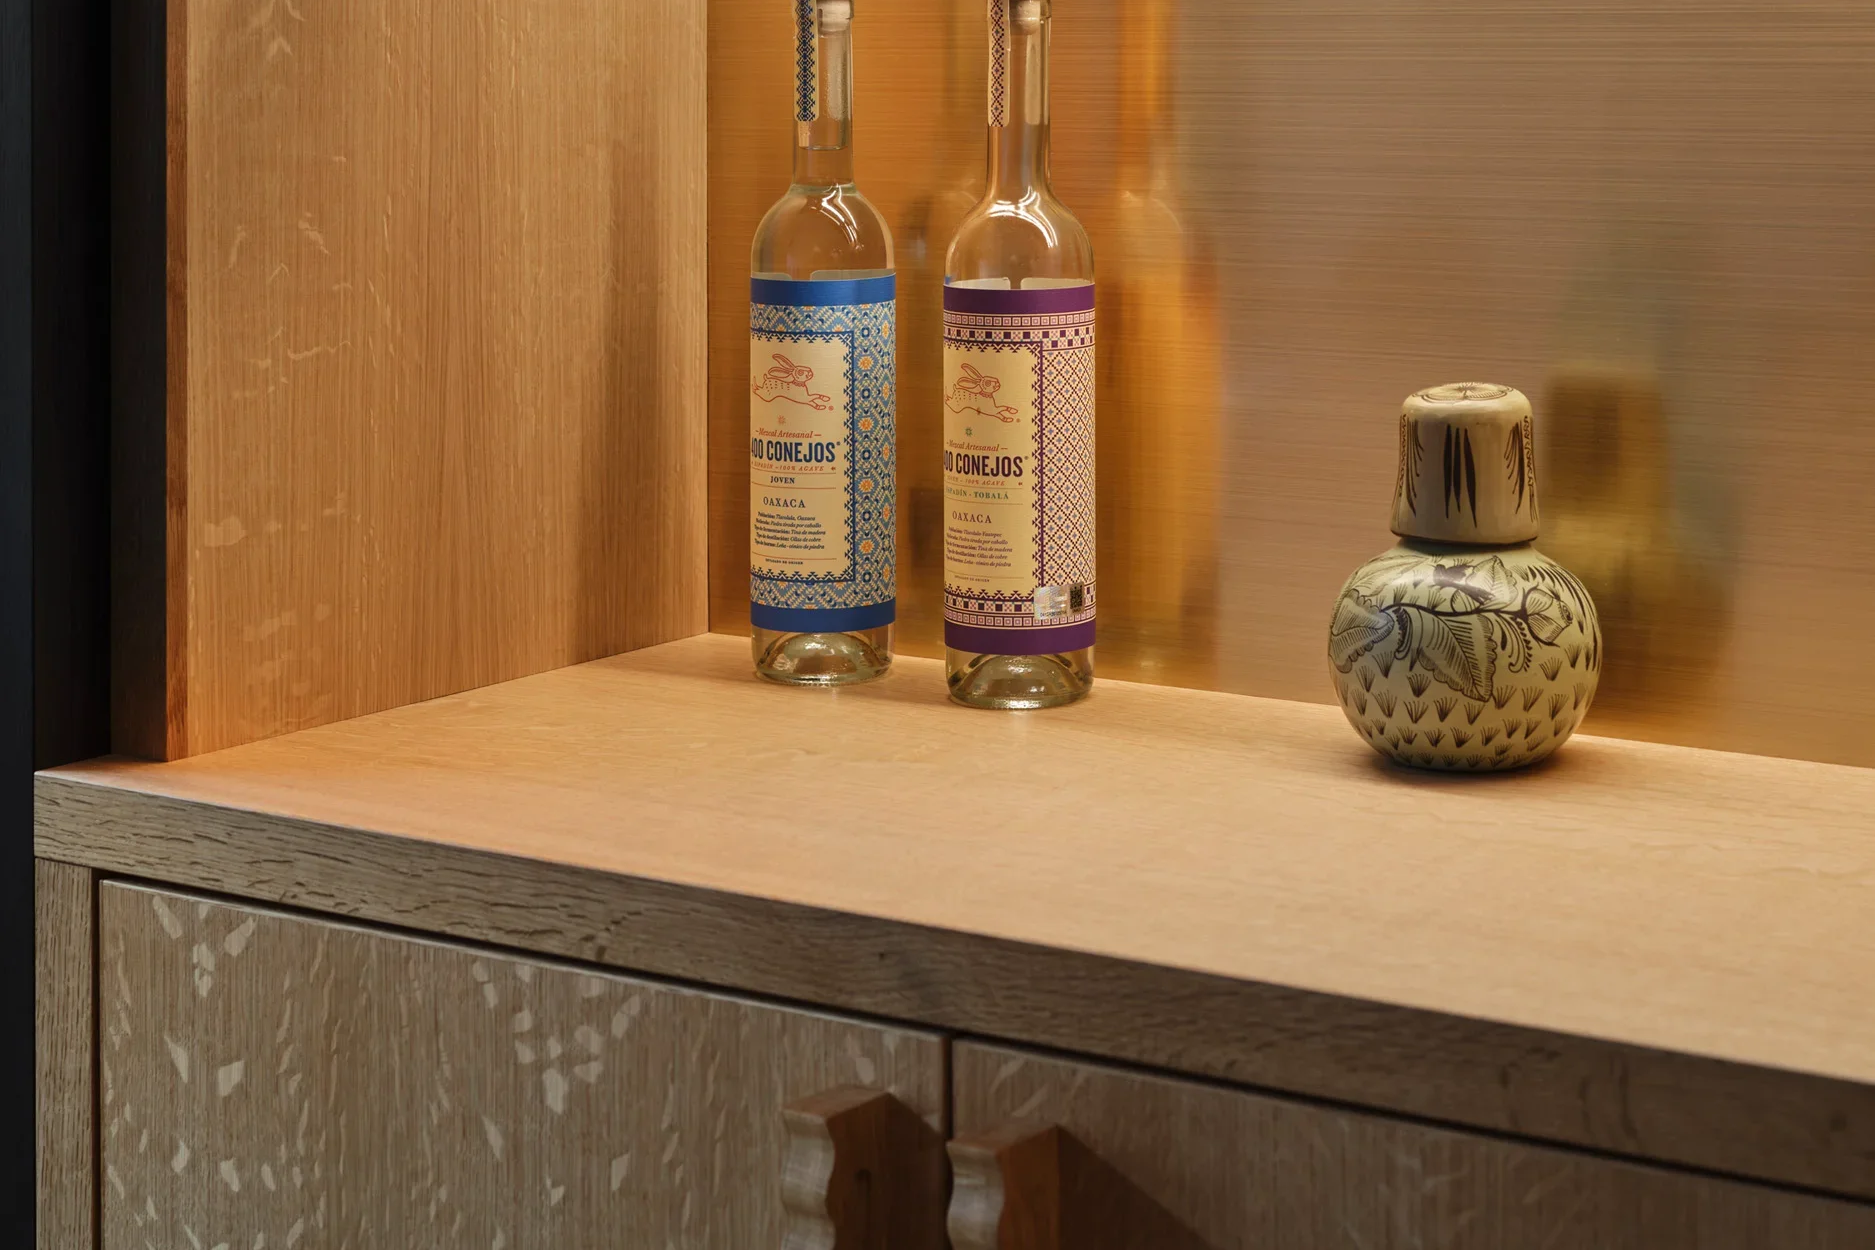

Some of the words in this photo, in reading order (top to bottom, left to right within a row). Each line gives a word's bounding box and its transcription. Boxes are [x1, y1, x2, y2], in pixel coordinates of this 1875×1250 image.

[759, 428, 777, 437] Mezcal
[778, 430, 814, 438] Artesanal
[766, 440, 836, 463] CONEJOS
[966, 442, 1000, 452] Artesanal
[956, 452, 1023, 477] CONEJOS
[770, 476, 795, 484] JOVEN
[974, 492, 1009, 500] TOBALÁ
[763, 496, 806, 508] OAXACA
[952, 510, 992, 524] OAXACA
